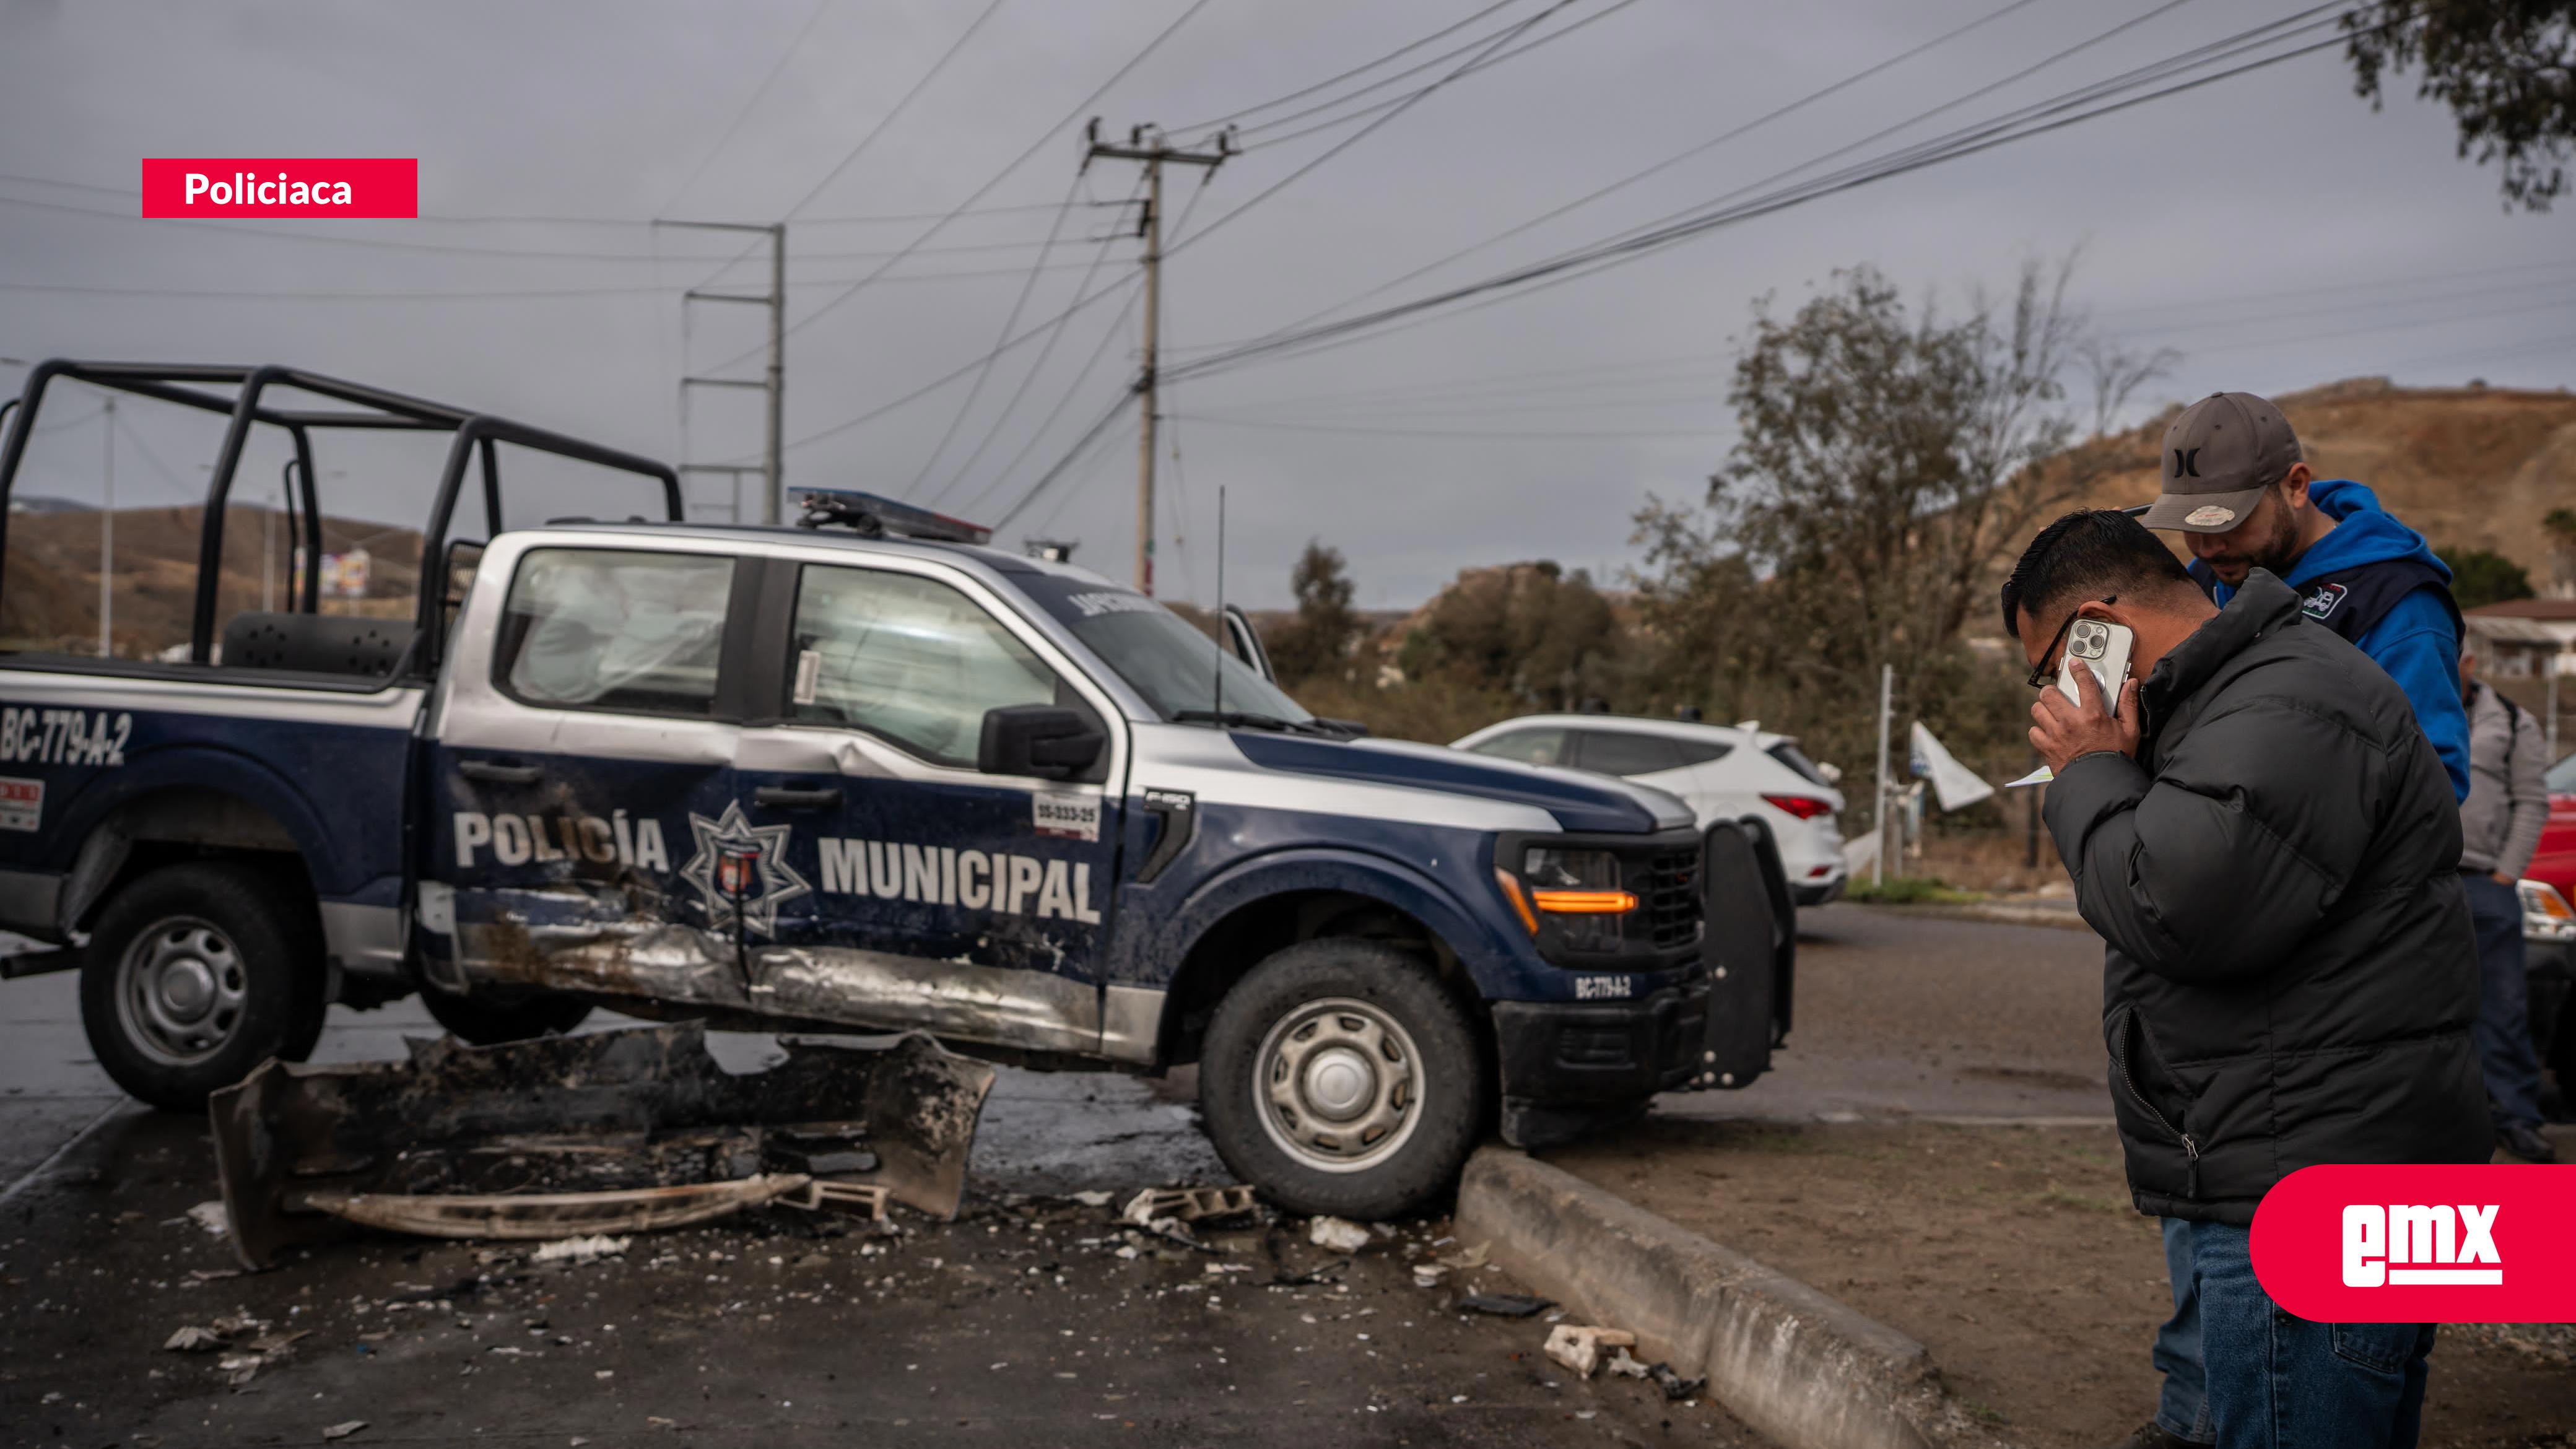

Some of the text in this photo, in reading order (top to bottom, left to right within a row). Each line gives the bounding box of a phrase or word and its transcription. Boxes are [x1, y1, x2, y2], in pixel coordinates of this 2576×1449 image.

[0, 707, 133, 766] BC-779-A-2
[453, 808, 1101, 925] POLICÍA MUNICIPAL
